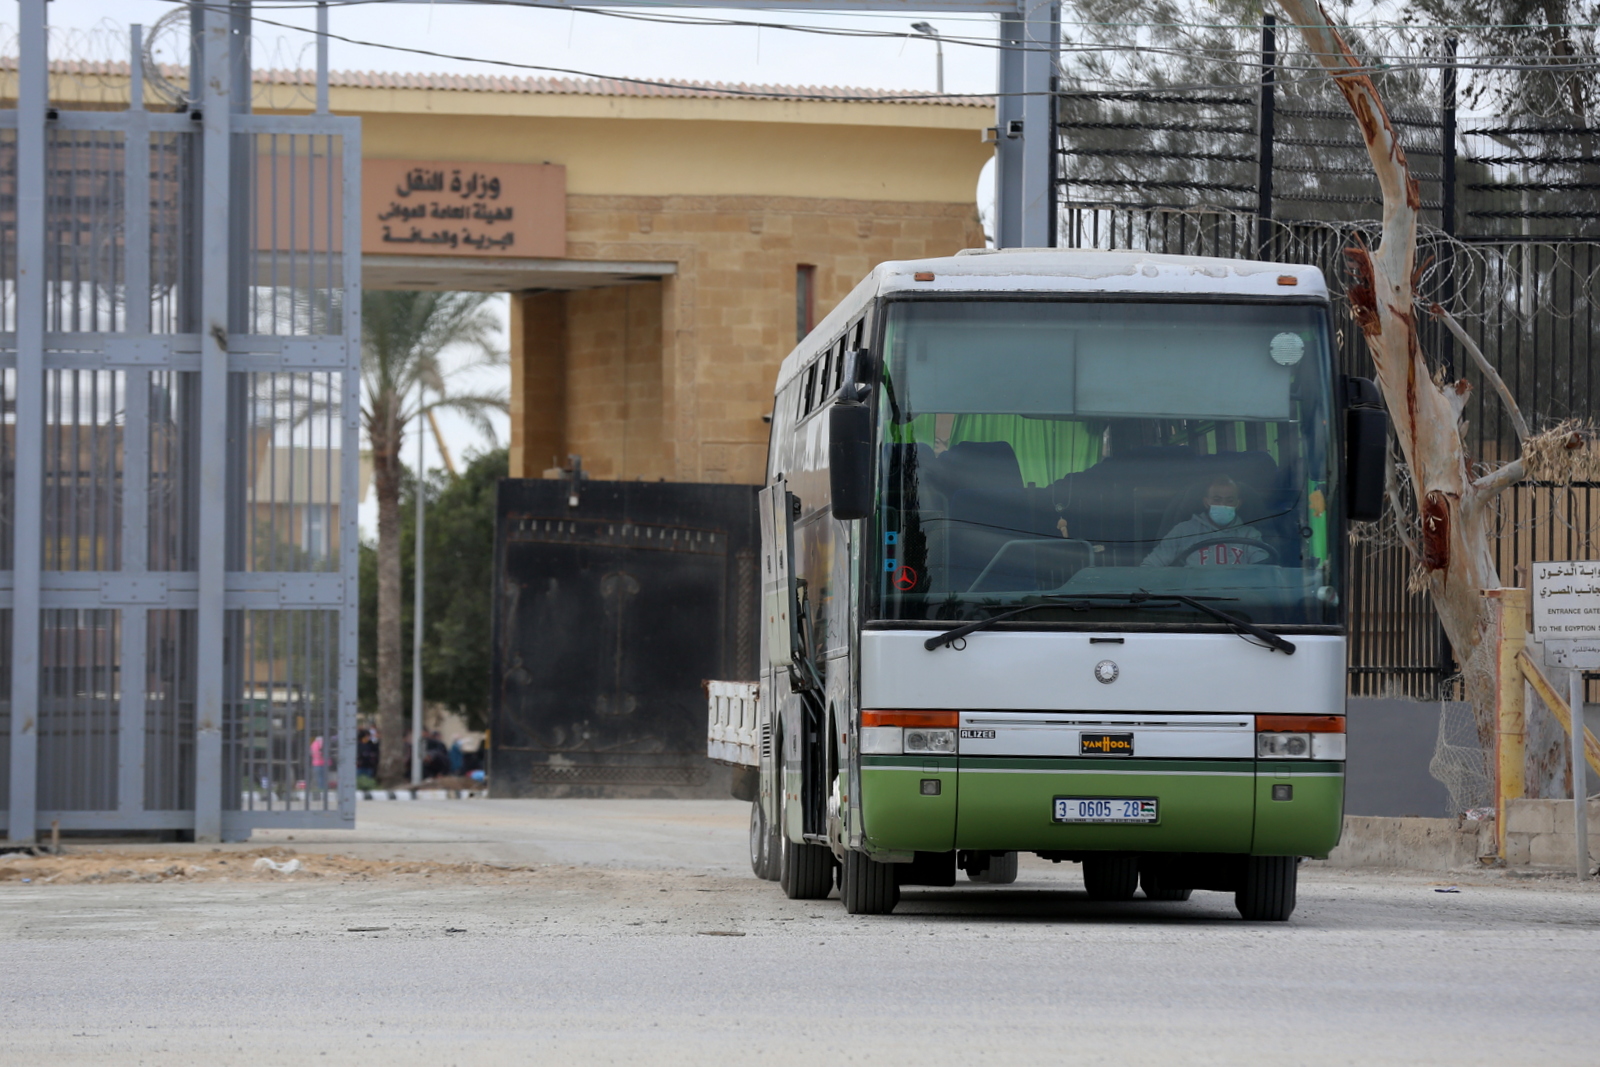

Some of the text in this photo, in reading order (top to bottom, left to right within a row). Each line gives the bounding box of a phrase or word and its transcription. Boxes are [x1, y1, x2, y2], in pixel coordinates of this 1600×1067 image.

[396, 168, 501, 199] وزارة النقل
[430, 202, 470, 221] العامة
[473, 202, 513, 224] الهيئة
[1199, 544, 1244, 565] FOX
[1539, 566, 1577, 580] الدخول
[1539, 585, 1573, 599] المصري
[961, 730, 995, 739] ALIZEE
